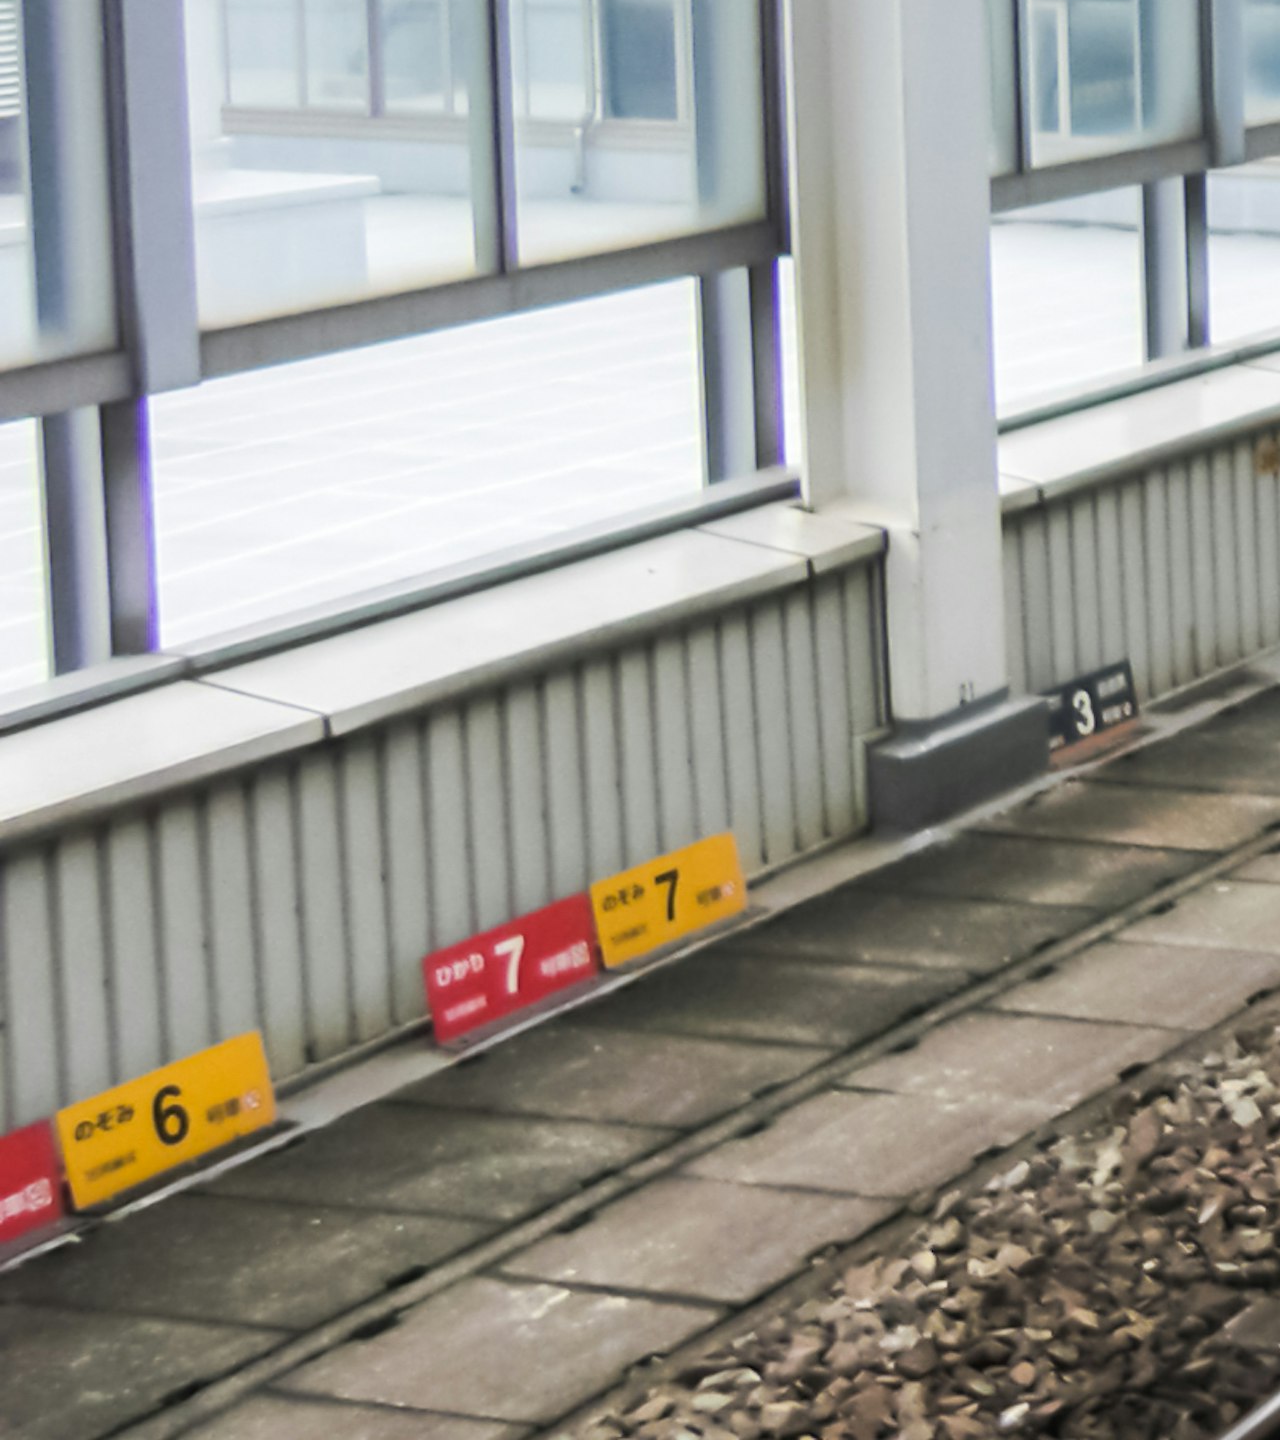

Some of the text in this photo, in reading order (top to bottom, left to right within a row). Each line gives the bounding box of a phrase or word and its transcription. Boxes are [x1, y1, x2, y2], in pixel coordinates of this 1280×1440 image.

[1071, 690, 1095, 736] 3
[603, 883, 645, 911] のぞみ
[655, 869, 679, 921] 7
[435, 952, 485, 987] ひかり
[494, 934, 524, 994] 7
[74, 1104, 134, 1141] のぞみ
[152, 1085, 189, 1145] 6
